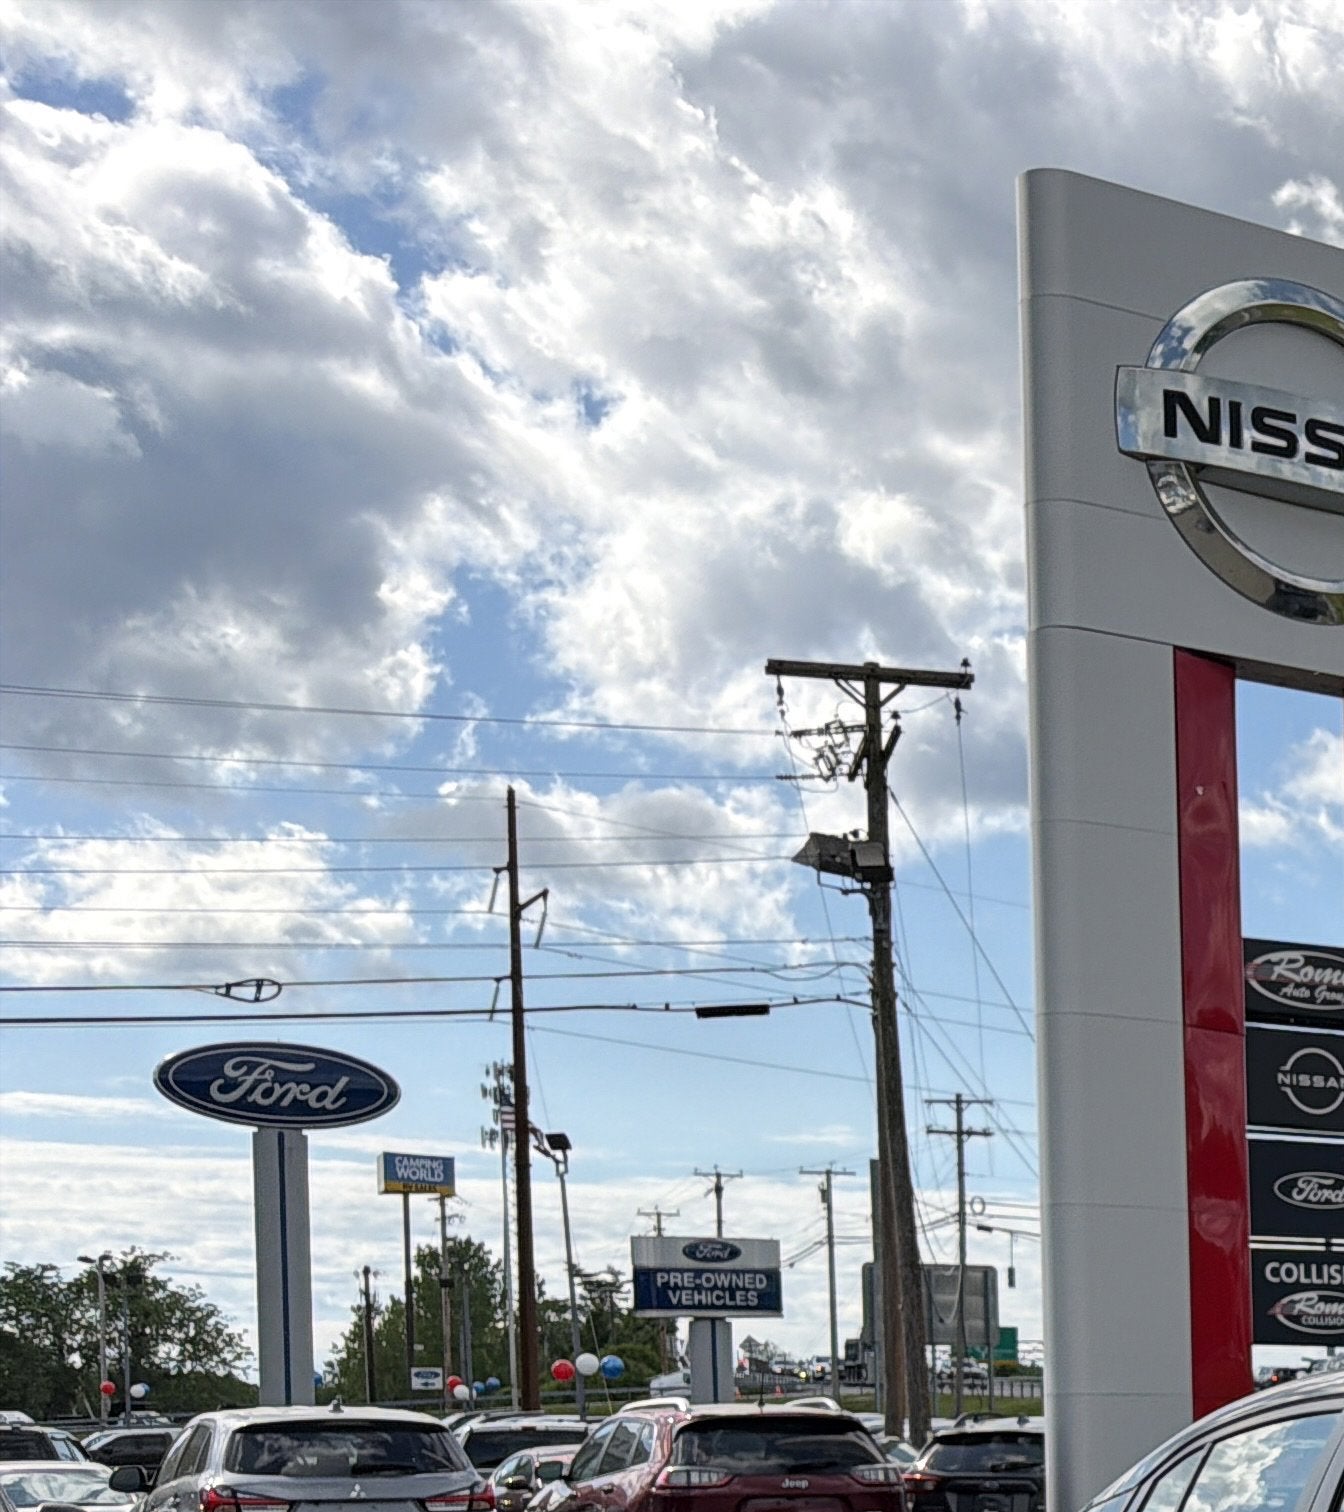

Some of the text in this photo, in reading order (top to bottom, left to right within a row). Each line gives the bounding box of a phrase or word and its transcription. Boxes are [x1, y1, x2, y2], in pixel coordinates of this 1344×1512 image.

[1280, 982, 1311, 998] Auto
[209, 1056, 350, 1110] Ford
[394, 1156, 444, 1169] CAMPING
[396, 1167, 444, 1182] WORLD
[695, 1243, 731, 1259] Ford
[656, 1271, 768, 1289] PRE-OWNED
[668, 1289, 759, 1307] VEHICLES
[781, 1478, 808, 1490] Jeep
